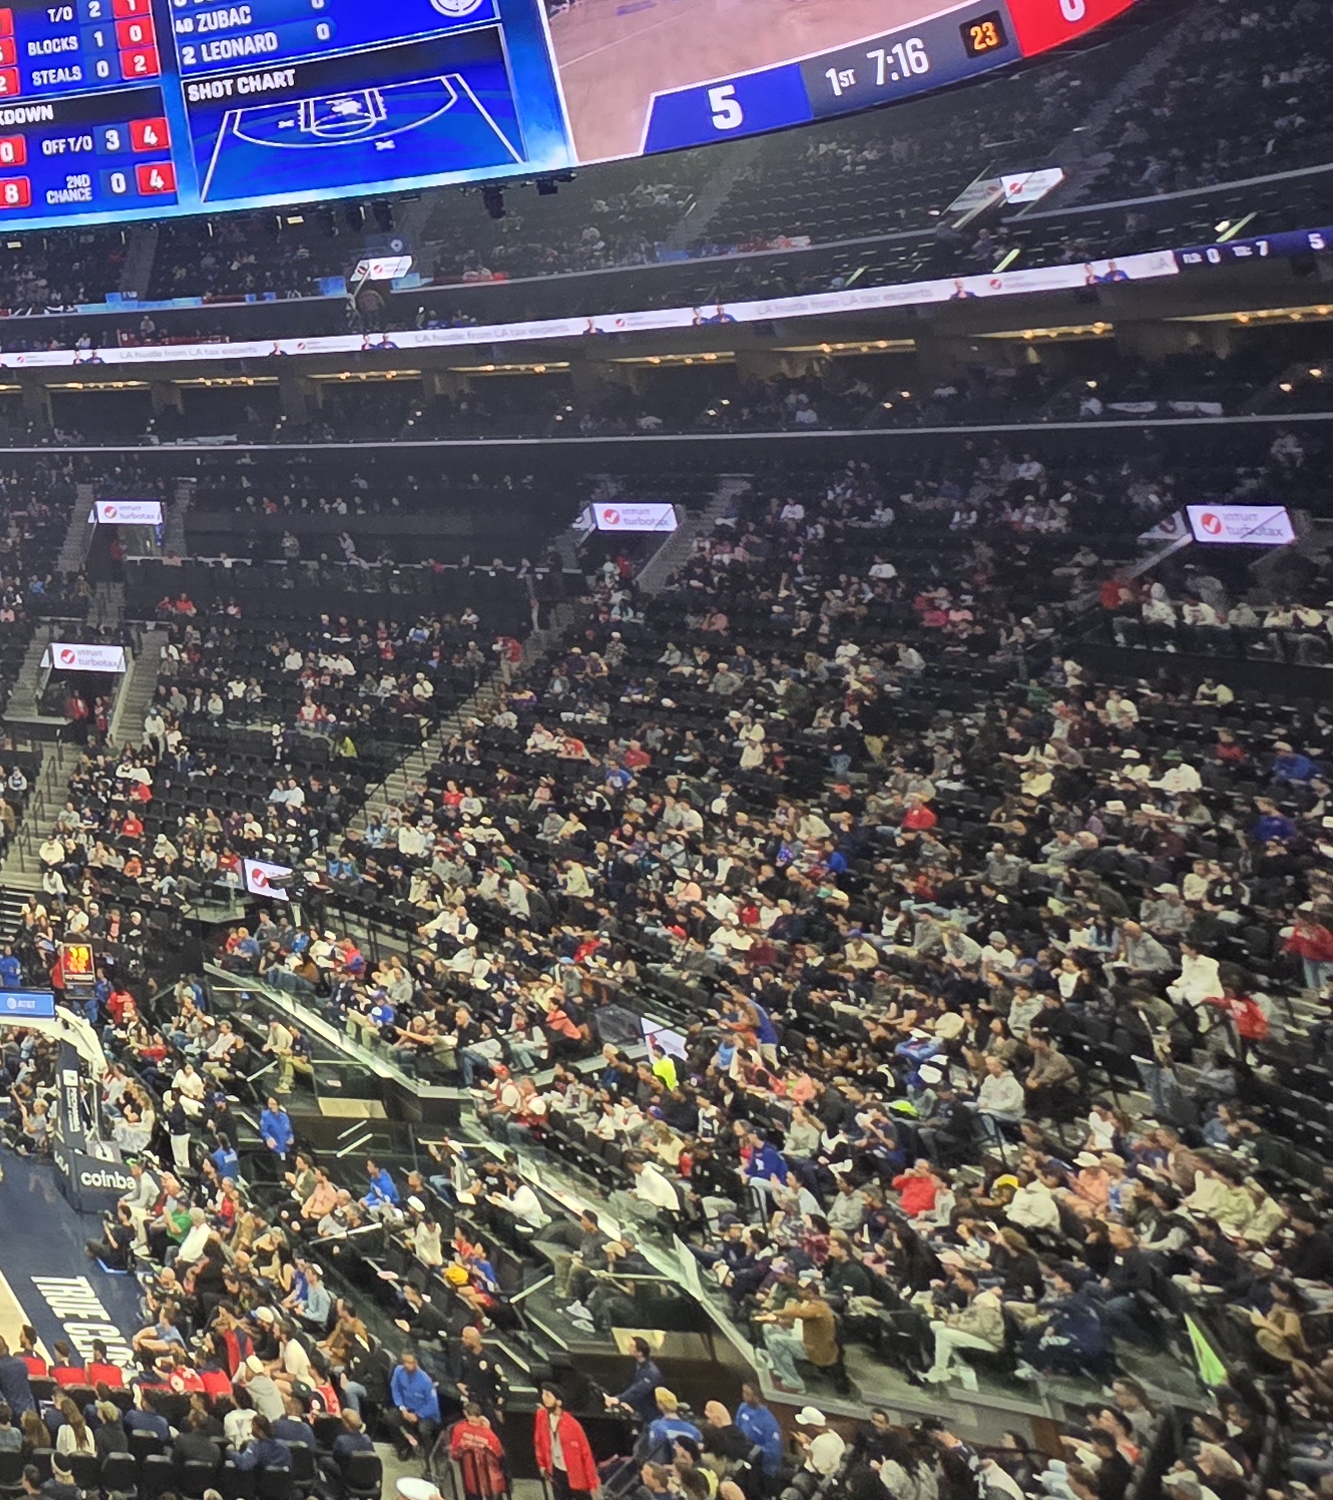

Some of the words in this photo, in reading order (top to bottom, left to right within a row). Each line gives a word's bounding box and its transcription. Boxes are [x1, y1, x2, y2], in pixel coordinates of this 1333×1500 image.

[187, 79, 233, 102] SHOT
[237, 69, 295, 94] CHART
[707, 84, 743, 129] 5
[826, 68, 856, 97] 1ST
[867, 37, 929, 86] 7:16
[970, 21, 998, 51] 23
[31, 1276, 111, 1321] TRUE
